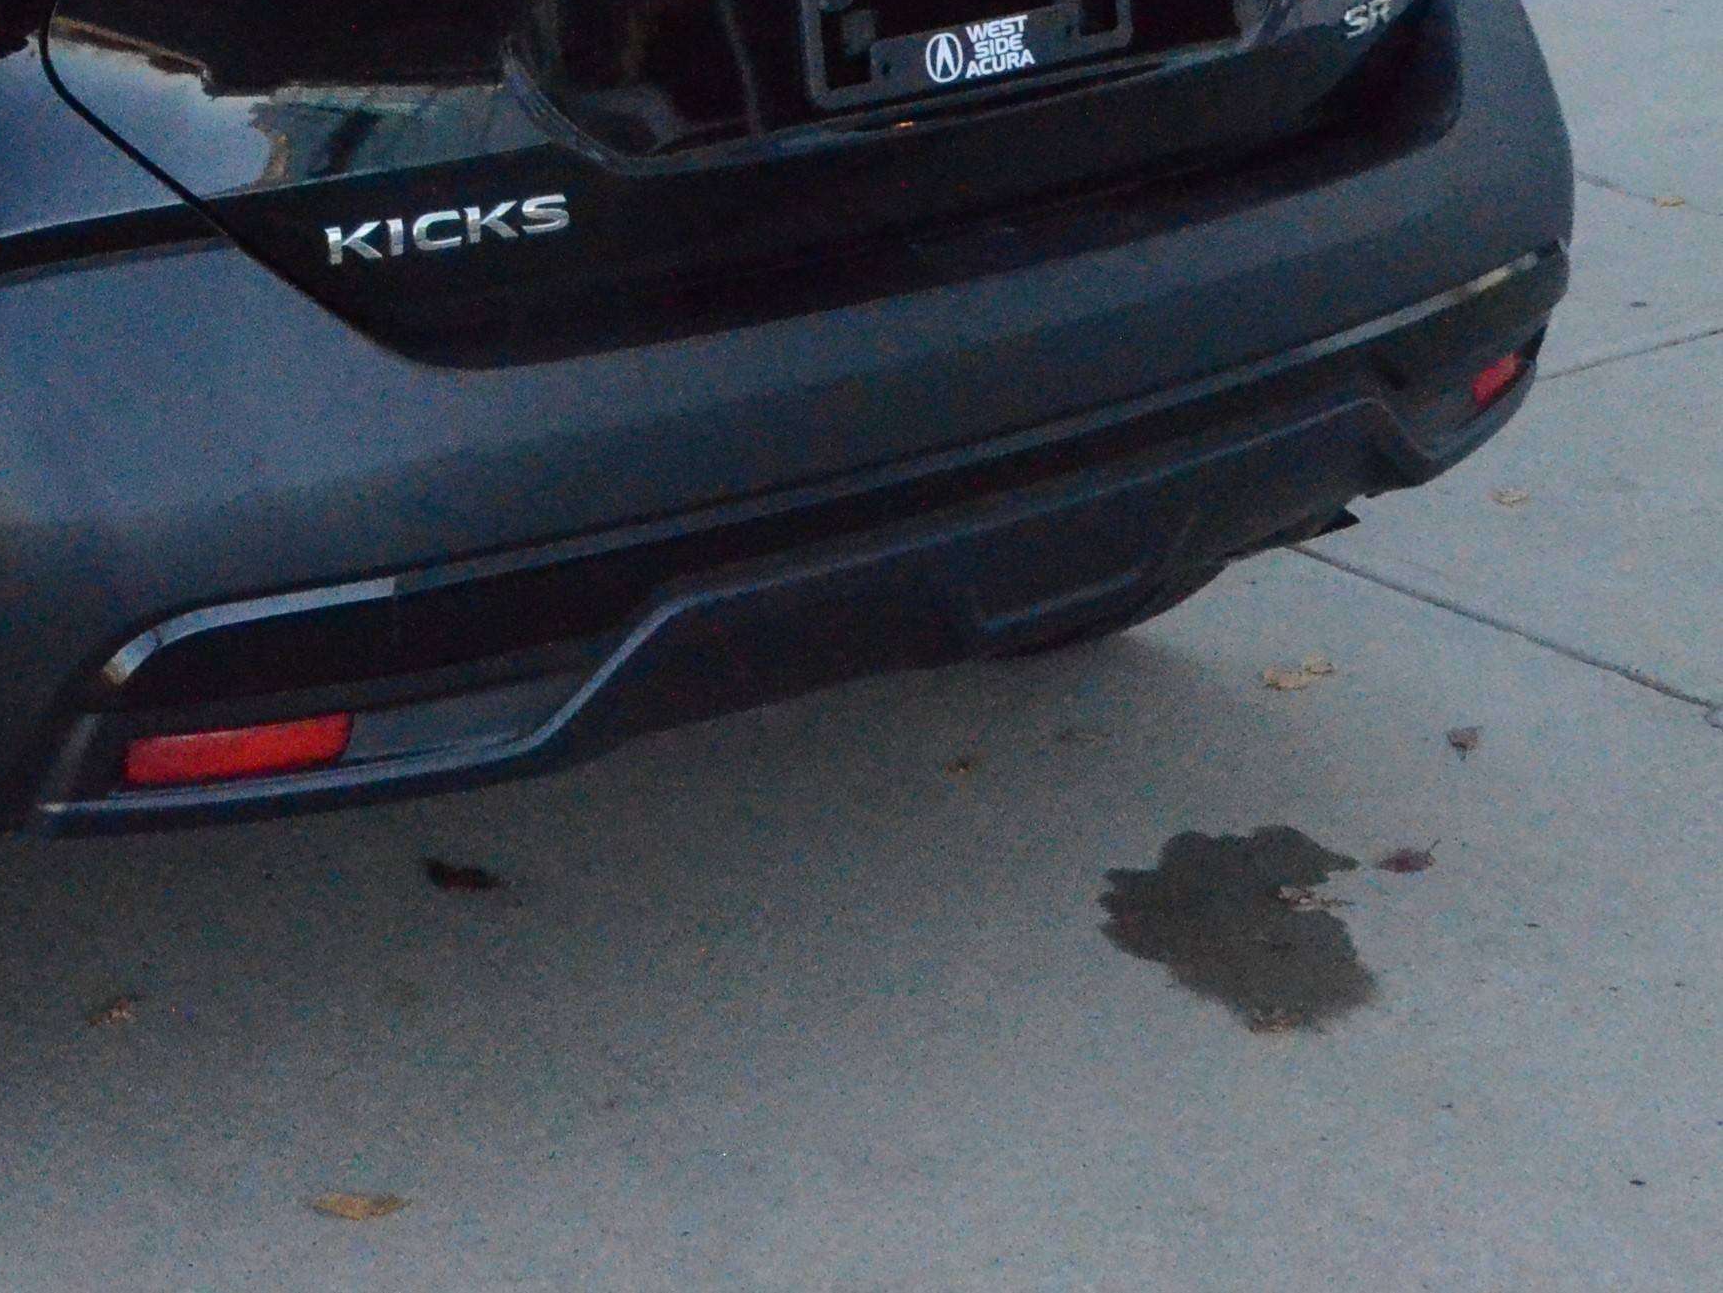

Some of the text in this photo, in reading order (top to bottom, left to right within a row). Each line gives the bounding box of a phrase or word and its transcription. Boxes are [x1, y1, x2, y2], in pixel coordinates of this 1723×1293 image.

[965, 14, 1028, 44] WEST
[974, 33, 1024, 58] SIDE
[964, 49, 1036, 79] ACURA
[324, 193, 571, 266] KICKS
